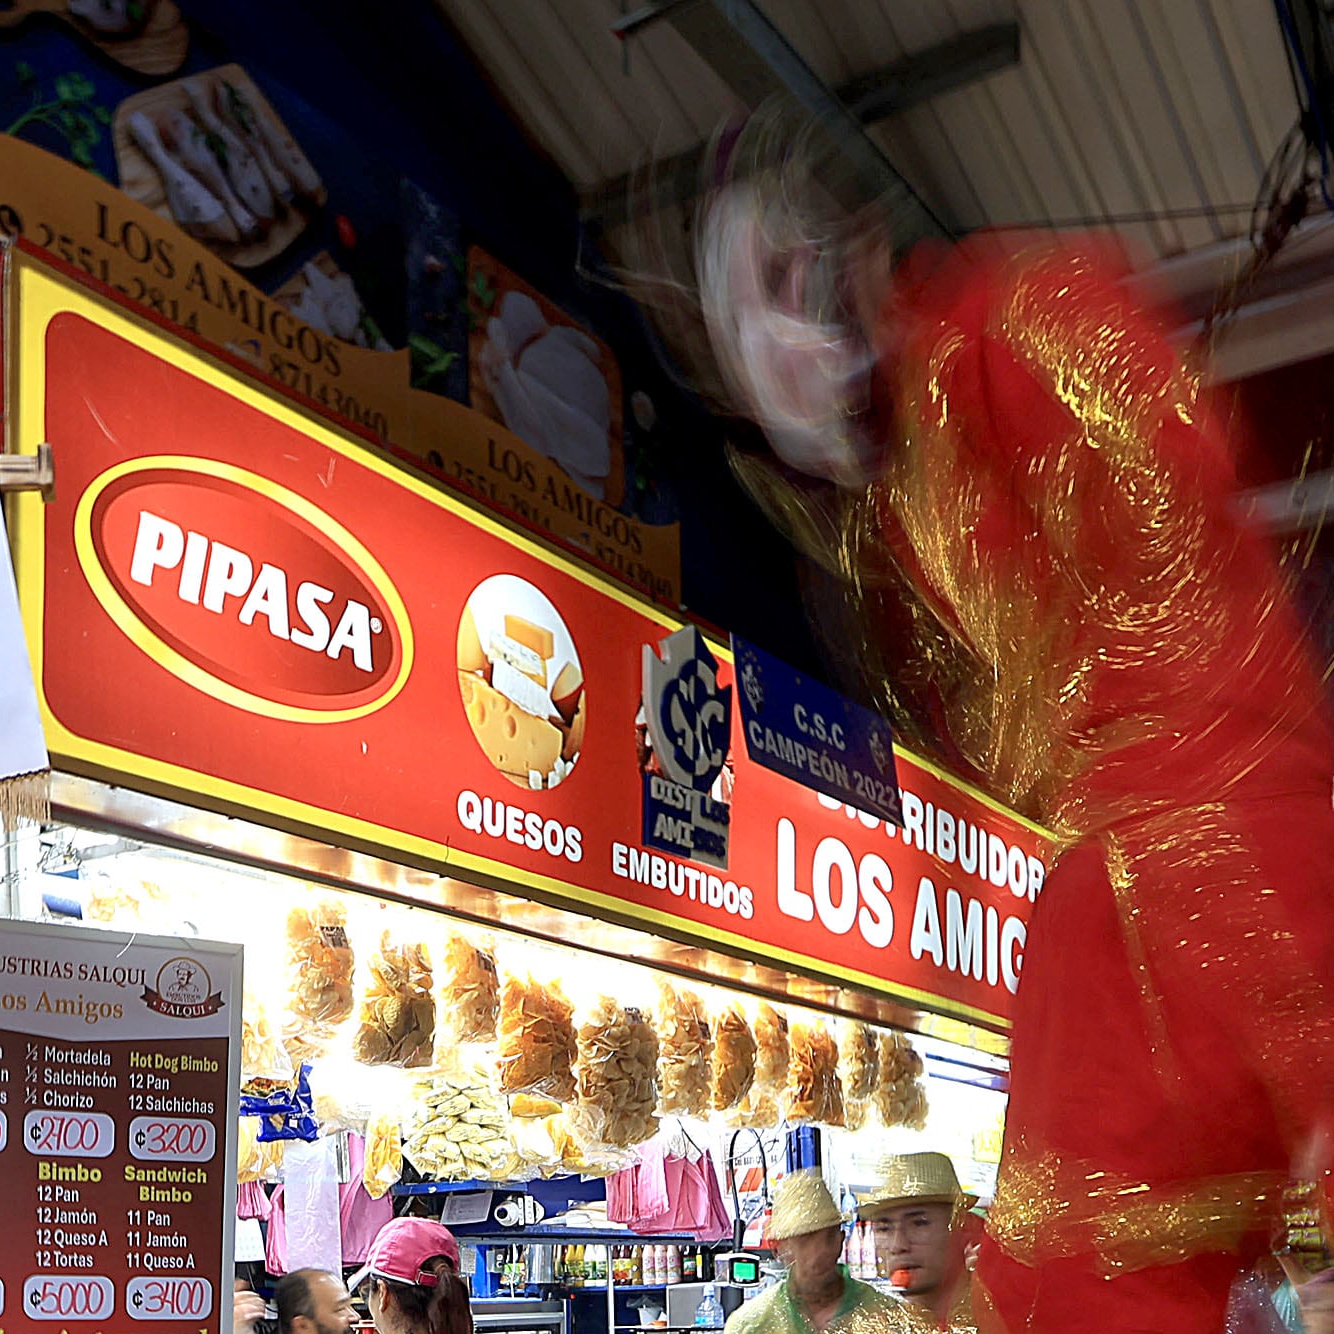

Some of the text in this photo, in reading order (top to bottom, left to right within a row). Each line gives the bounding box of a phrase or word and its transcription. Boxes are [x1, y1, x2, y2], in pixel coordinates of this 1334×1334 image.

[97, 202, 343, 378] LOS AMIGOS
[488, 439, 643, 555] LOS AMIGOS
[130, 510, 373, 672] PIPASA
[748, 720, 898, 810] CAMPEÓN 2022
[457, 790, 583, 863] QUESOS
[612, 841, 754, 919] EMBUTIDOS
[777, 816, 894, 948] LOS
[78, 964, 147, 986] SALQUI
[34, 992, 124, 1025] Amigos
[160, 1002, 205, 1017] SALQUI
[44, 1045, 111, 1067] Mortadela
[130, 1051, 218, 1073] Hot Dog Bimbo
[43, 1068, 117, 1089] Salchichón
[129, 1073, 170, 1091] 12 Pan
[43, 1089, 94, 1109] Chorizo
[128, 1095, 214, 1115] 12 Salchichas
[38, 1161, 102, 1182] Bimbo
[124, 1165, 208, 1184] Sandwich
[37, 1185, 80, 1203] 12 Pan
[139, 1185, 193, 1203] Bimbo
[36, 1207, 97, 1225] 12 Jamón
[127, 1210, 171, 1226] 11 Pan
[36, 1229, 108, 1248] 12 Queso A
[126, 1231, 187, 1248] 11 Jamón
[35, 1251, 94, 1268] 12 Tortas
[126, 1253, 195, 1271] 11 Queso A
